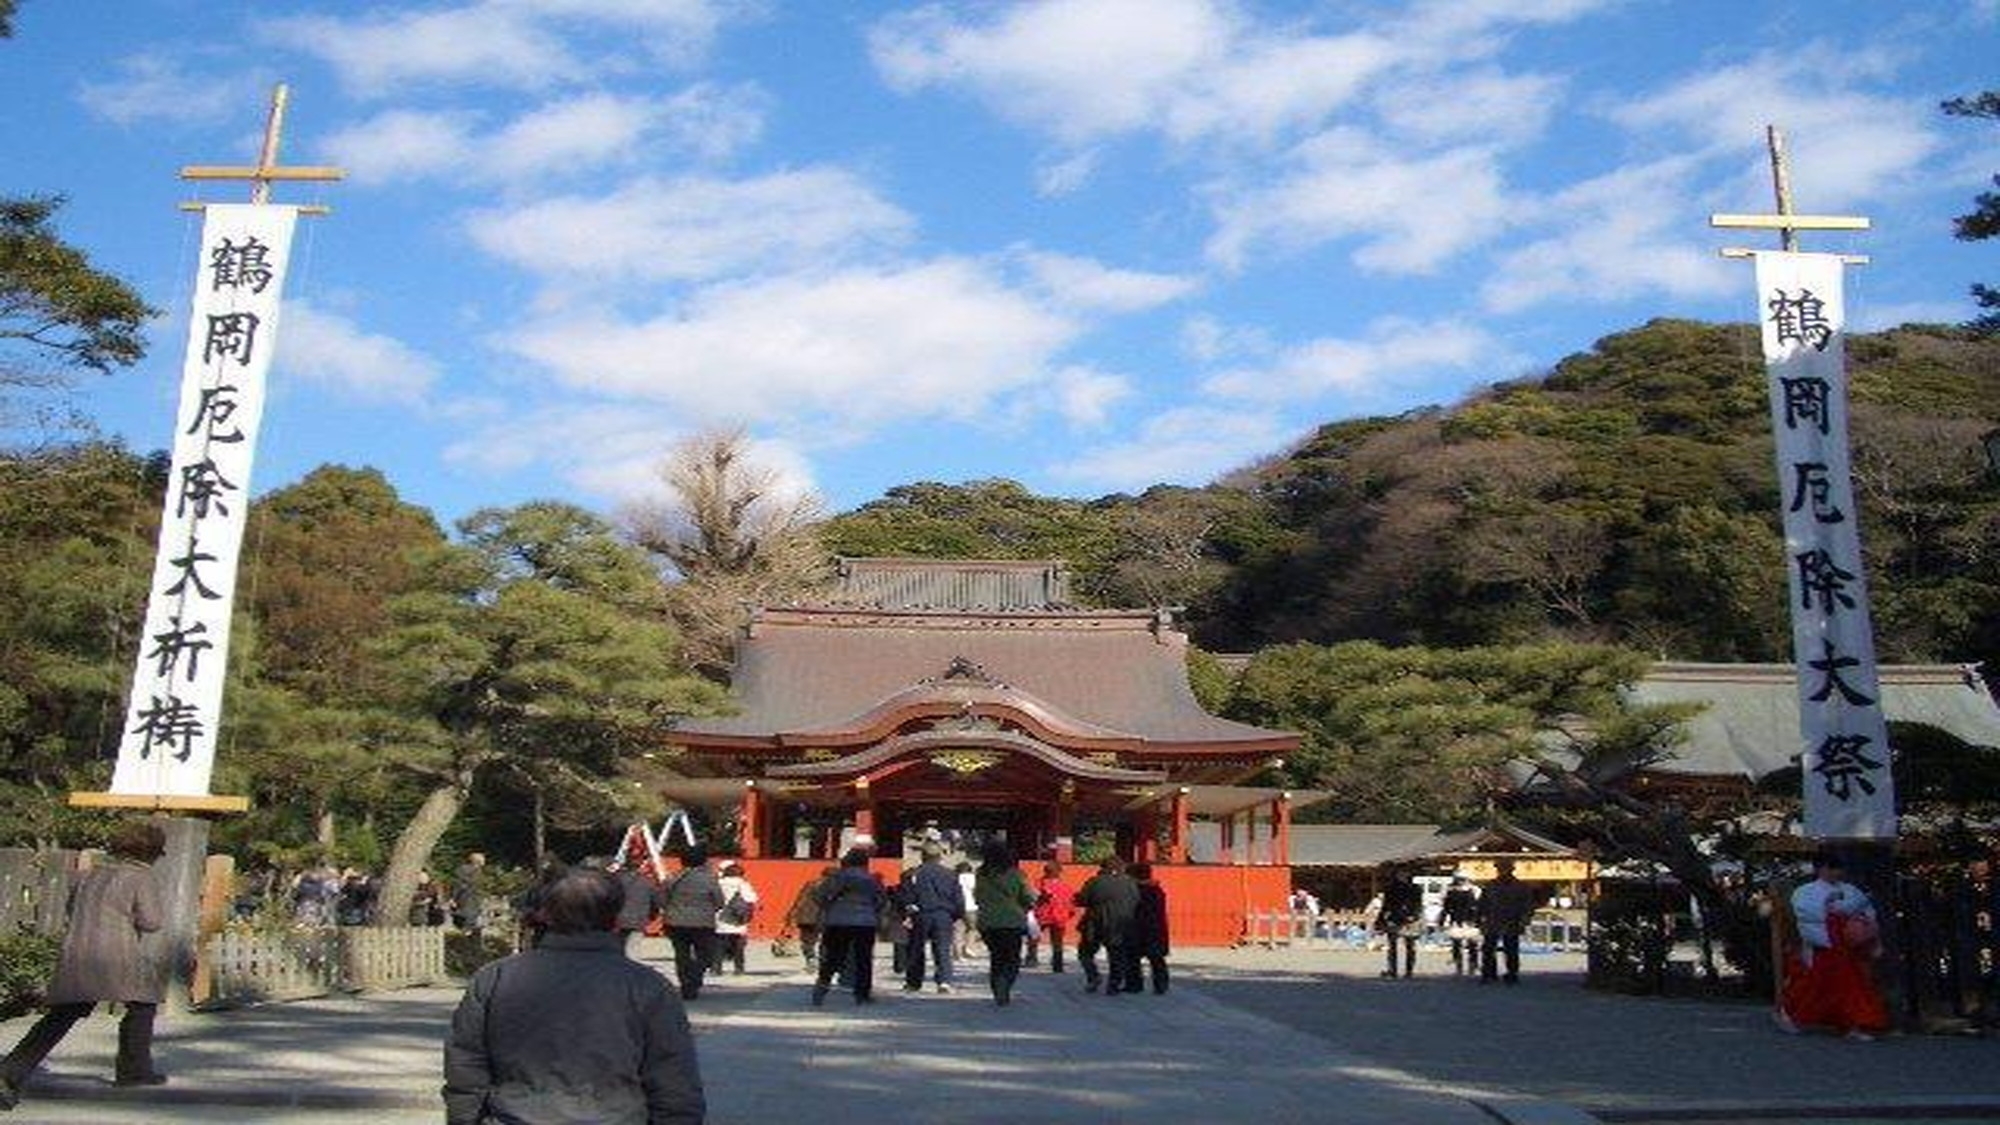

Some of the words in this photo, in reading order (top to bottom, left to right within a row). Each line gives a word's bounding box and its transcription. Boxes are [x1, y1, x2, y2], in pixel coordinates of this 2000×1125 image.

[1768, 287, 1885, 802] 鶴岡厄除大祭
